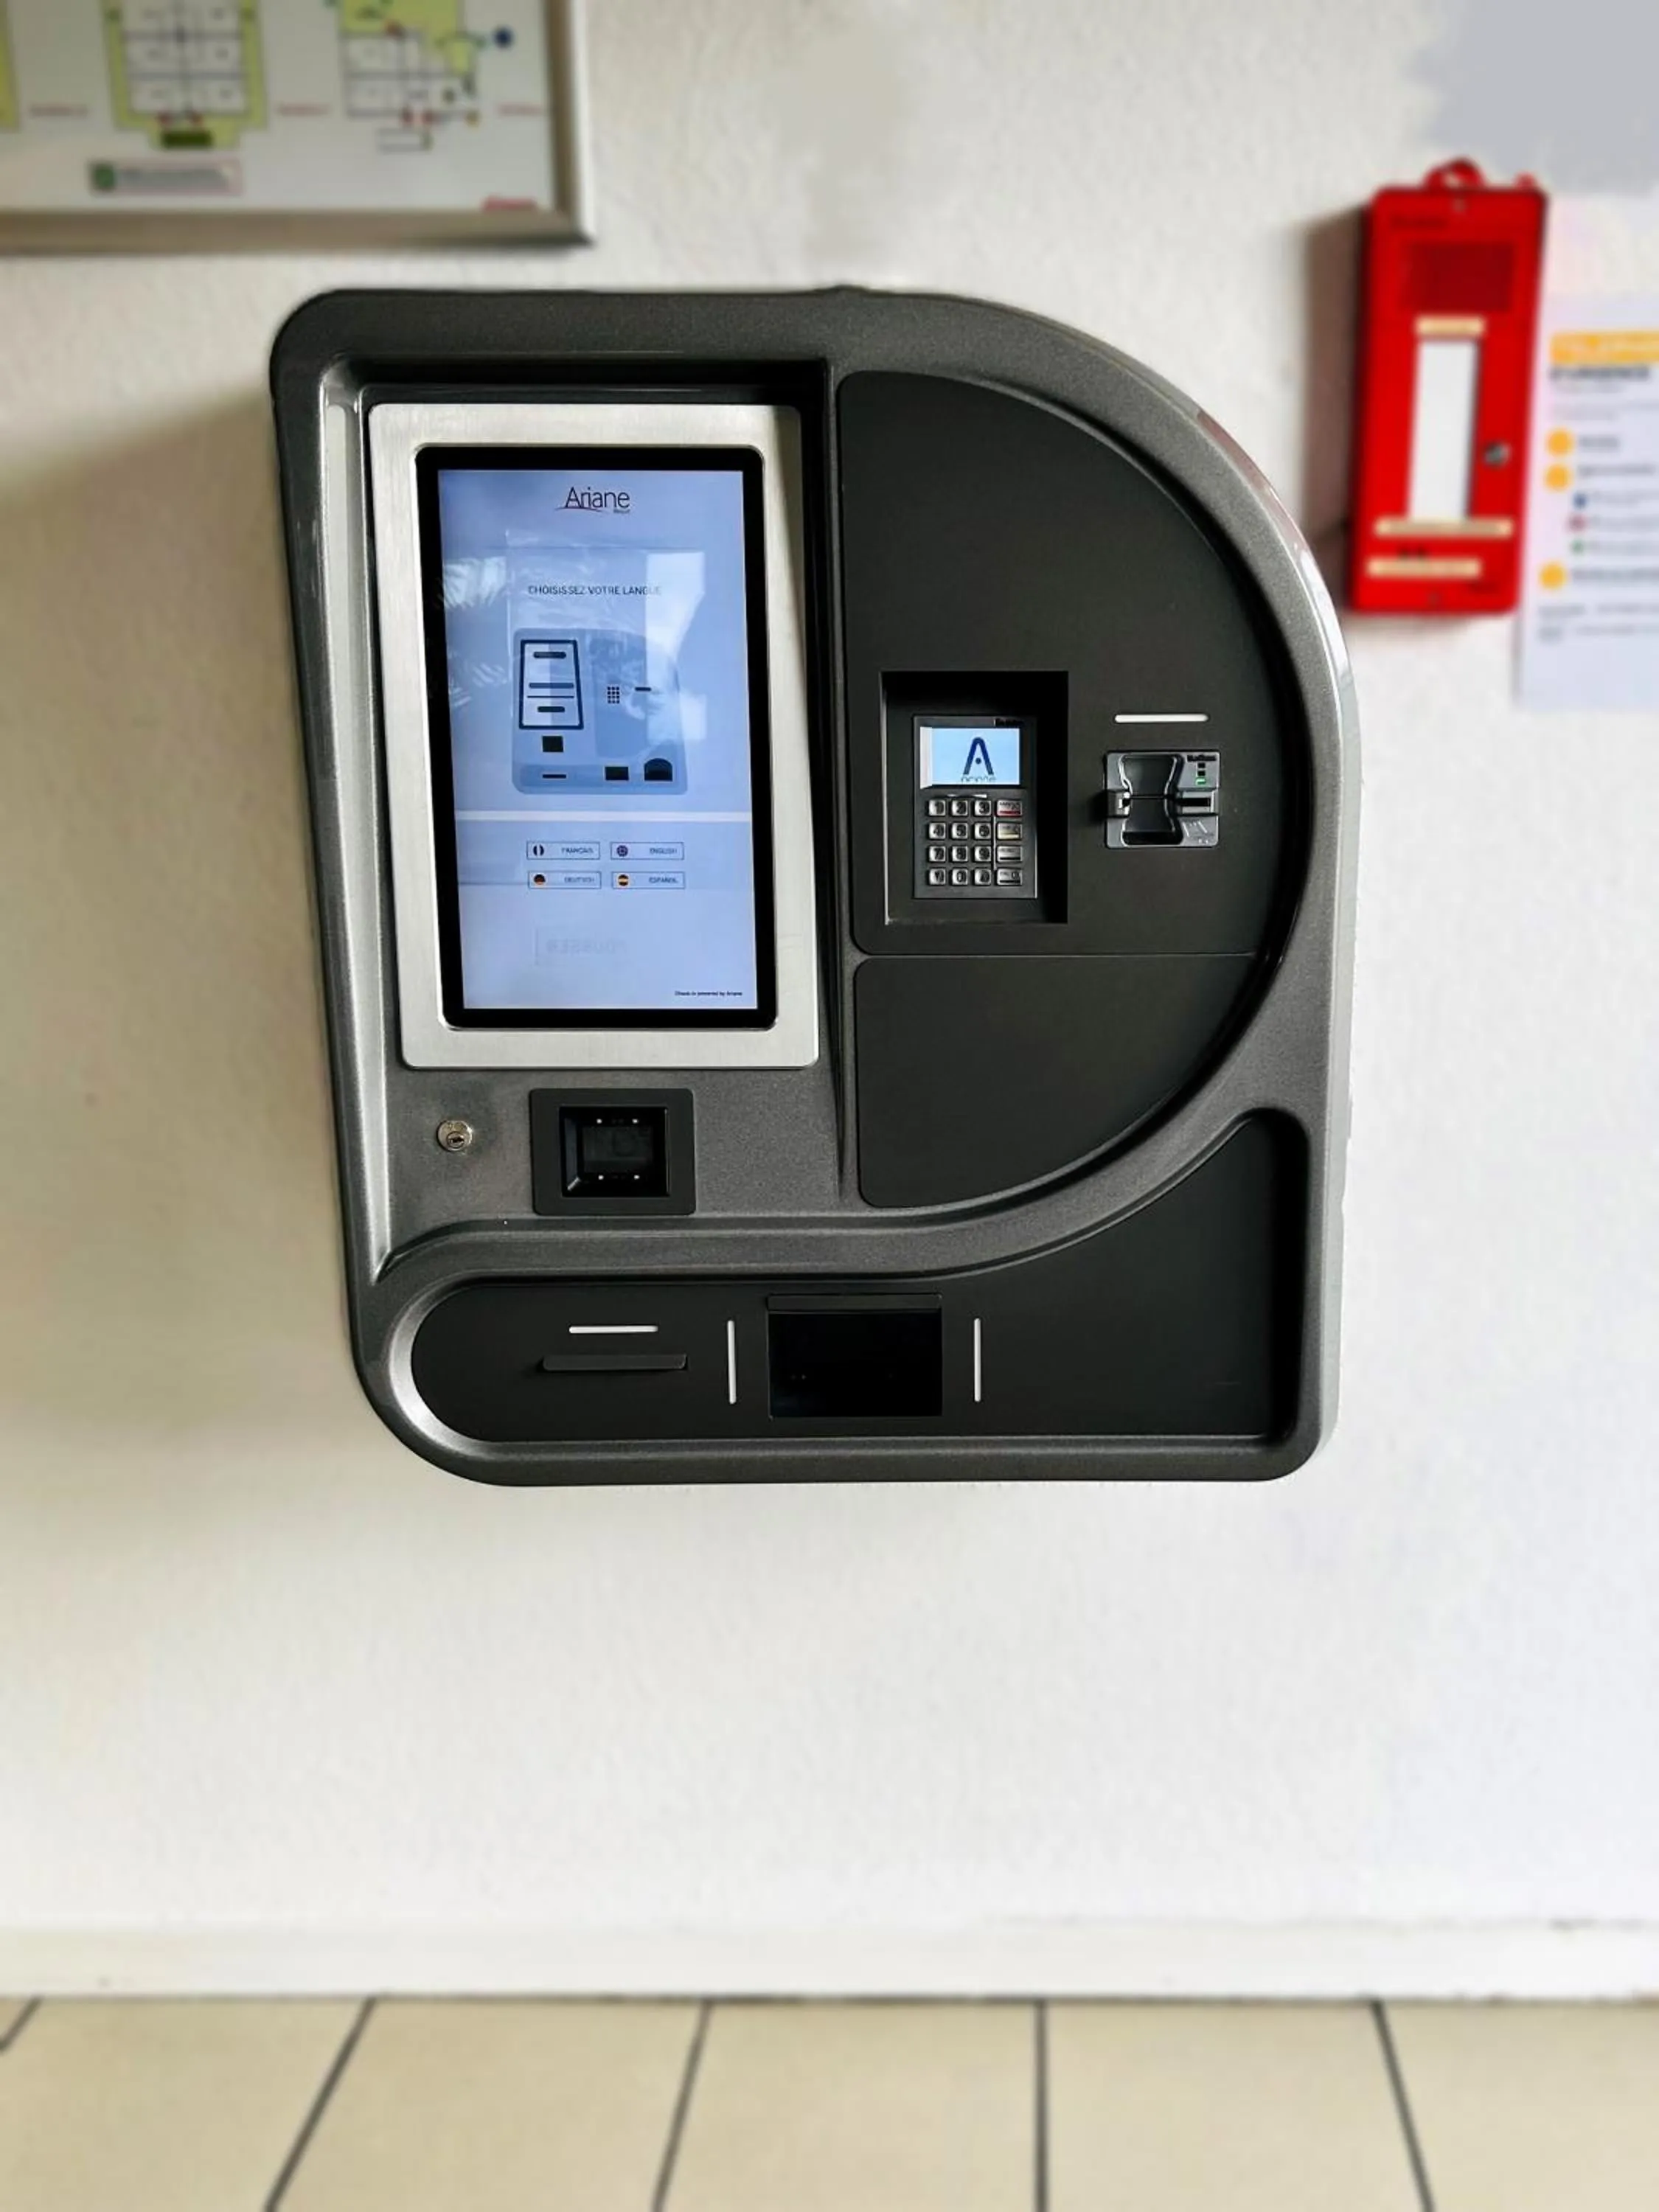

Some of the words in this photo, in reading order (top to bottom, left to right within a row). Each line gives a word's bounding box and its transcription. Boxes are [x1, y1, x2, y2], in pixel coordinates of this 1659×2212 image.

[563, 486, 630, 509] Ariane
[528, 585, 585, 595] CHOISISSEZ
[588, 585, 620, 595] VOTRE
[956, 801, 967, 814] 2
[978, 801, 990, 814] 3
[956, 824, 967, 837] 5
[933, 846, 944, 860] 7
